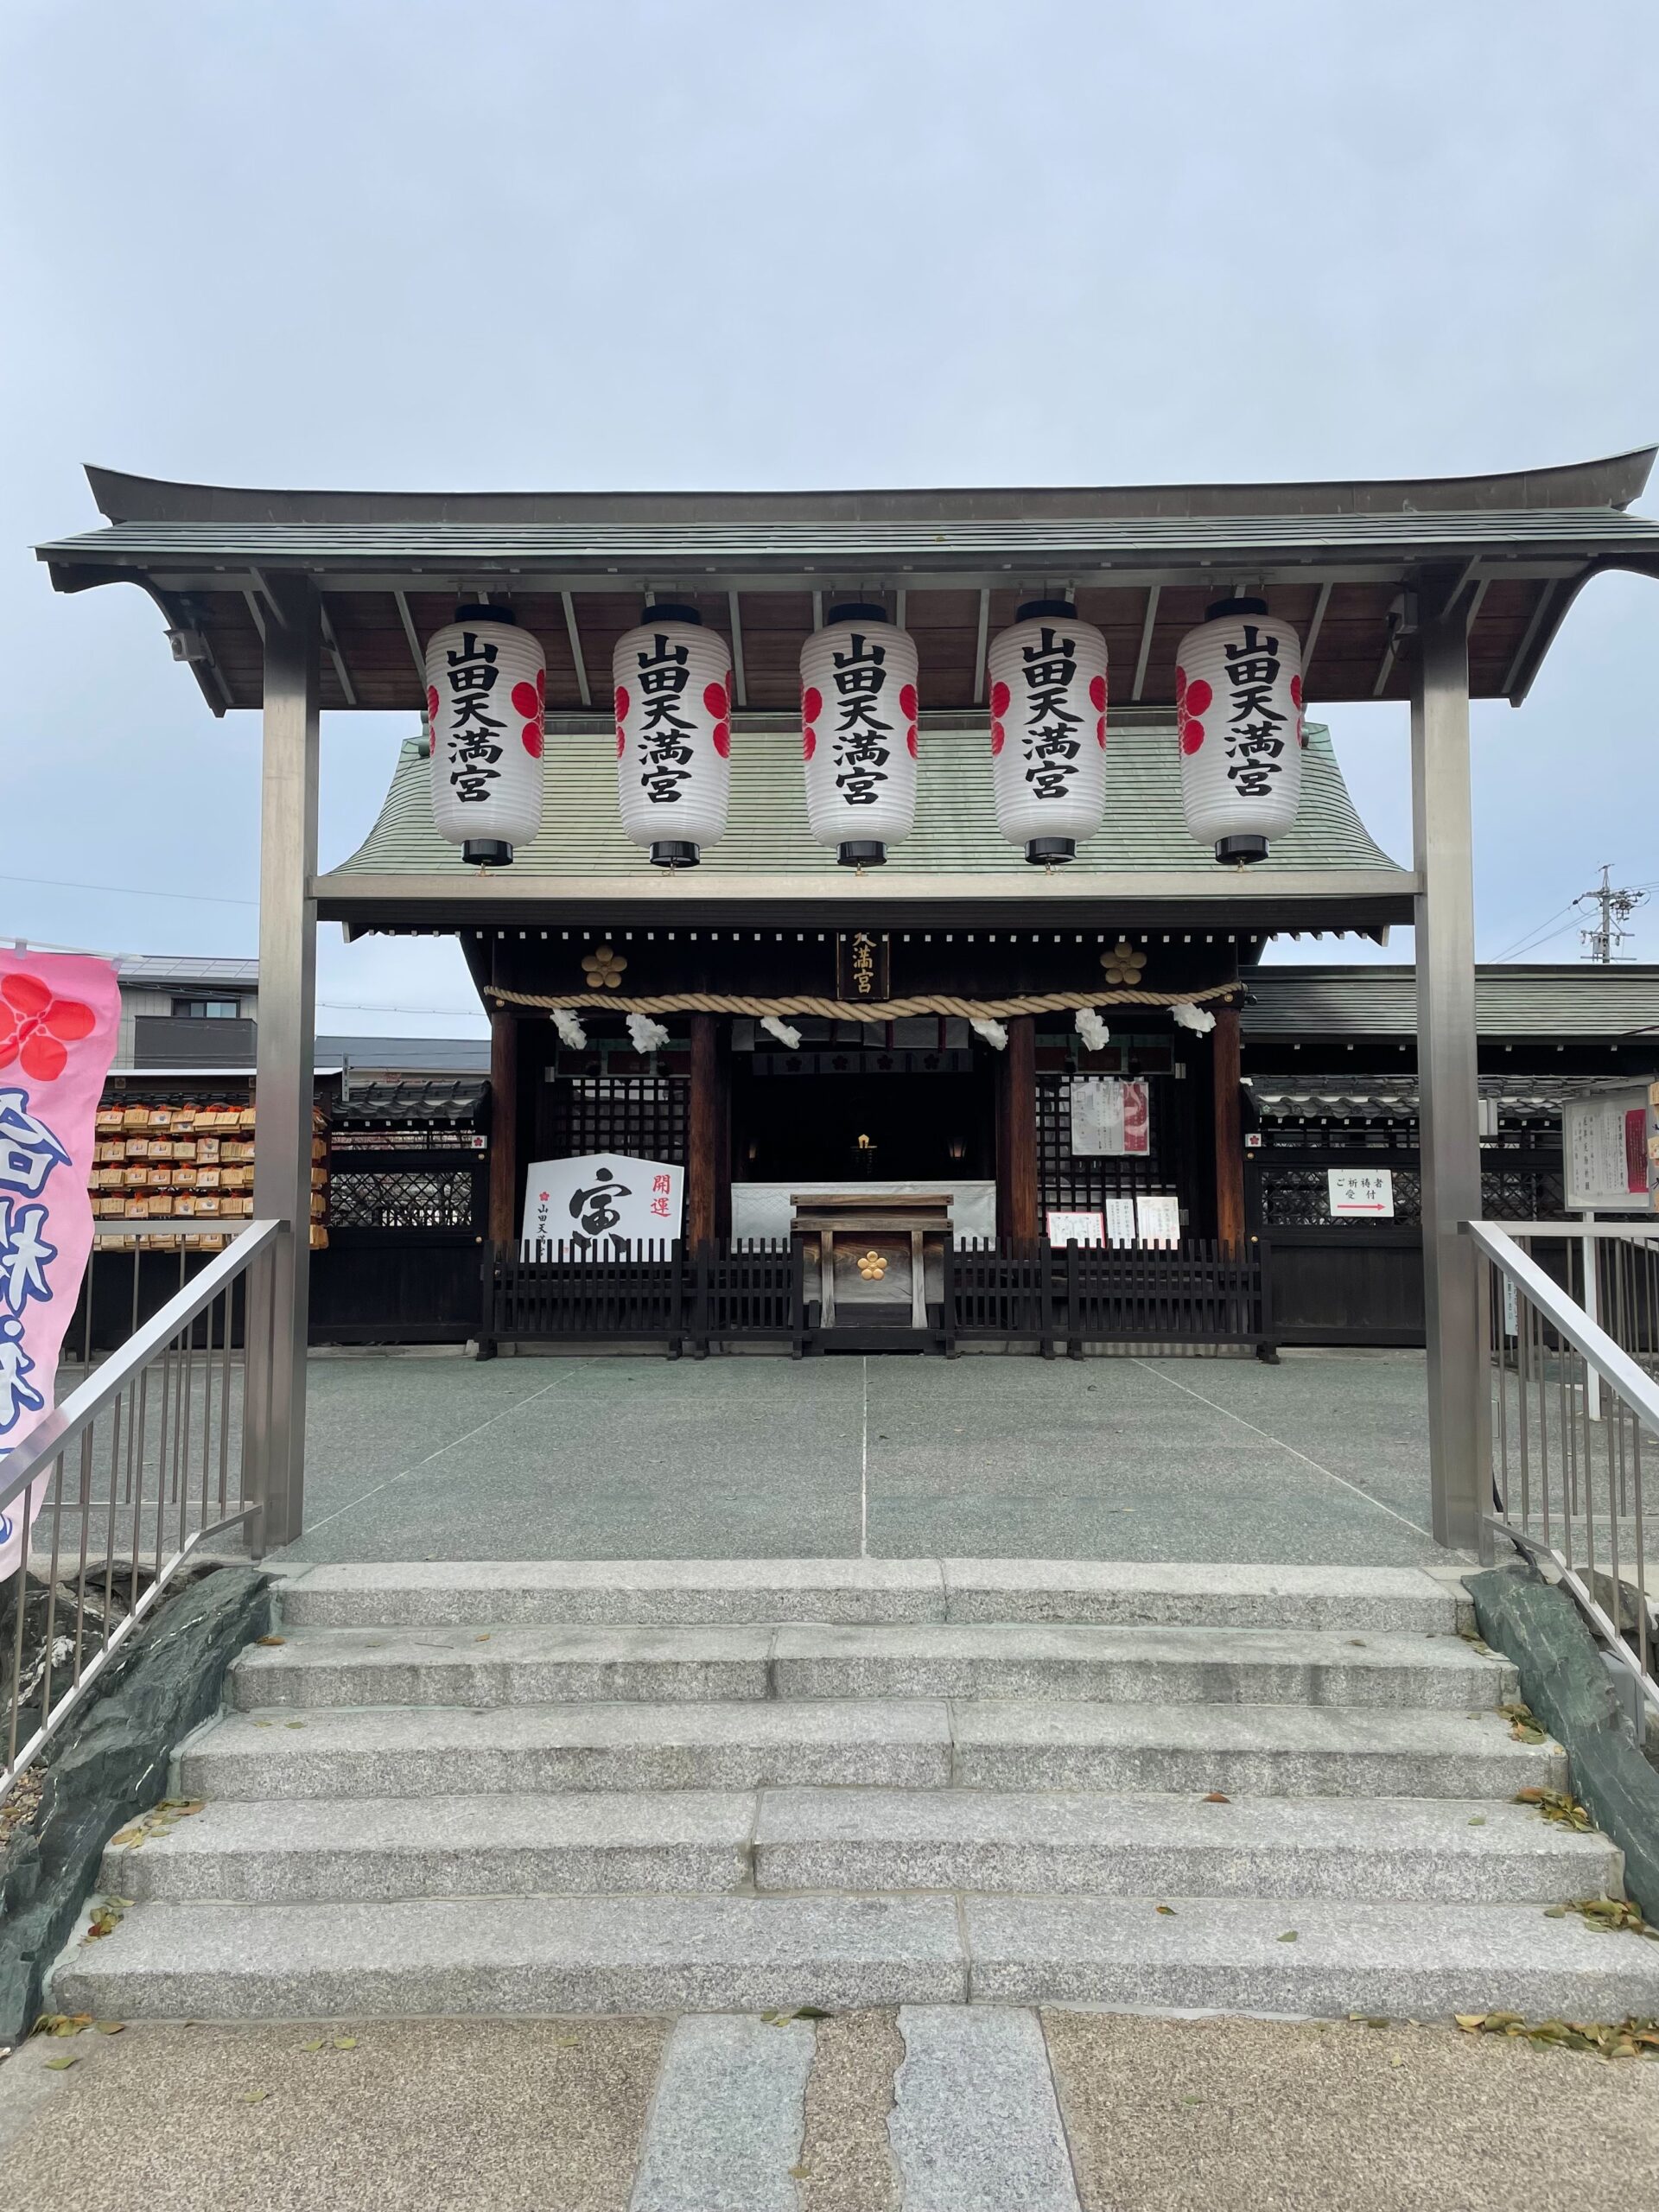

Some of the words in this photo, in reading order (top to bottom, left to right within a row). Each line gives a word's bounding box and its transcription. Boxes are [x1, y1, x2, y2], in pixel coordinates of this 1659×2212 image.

[447, 632, 508, 803] 山田天満宮
[638, 633, 698, 804] 山田天満宮
[832, 633, 895, 805] 山田天満宮
[1021, 627, 1085, 800] 山田天満宮
[1224, 625, 1288, 798] 山田天満宮
[650, 1173, 672, 1217] 開運
